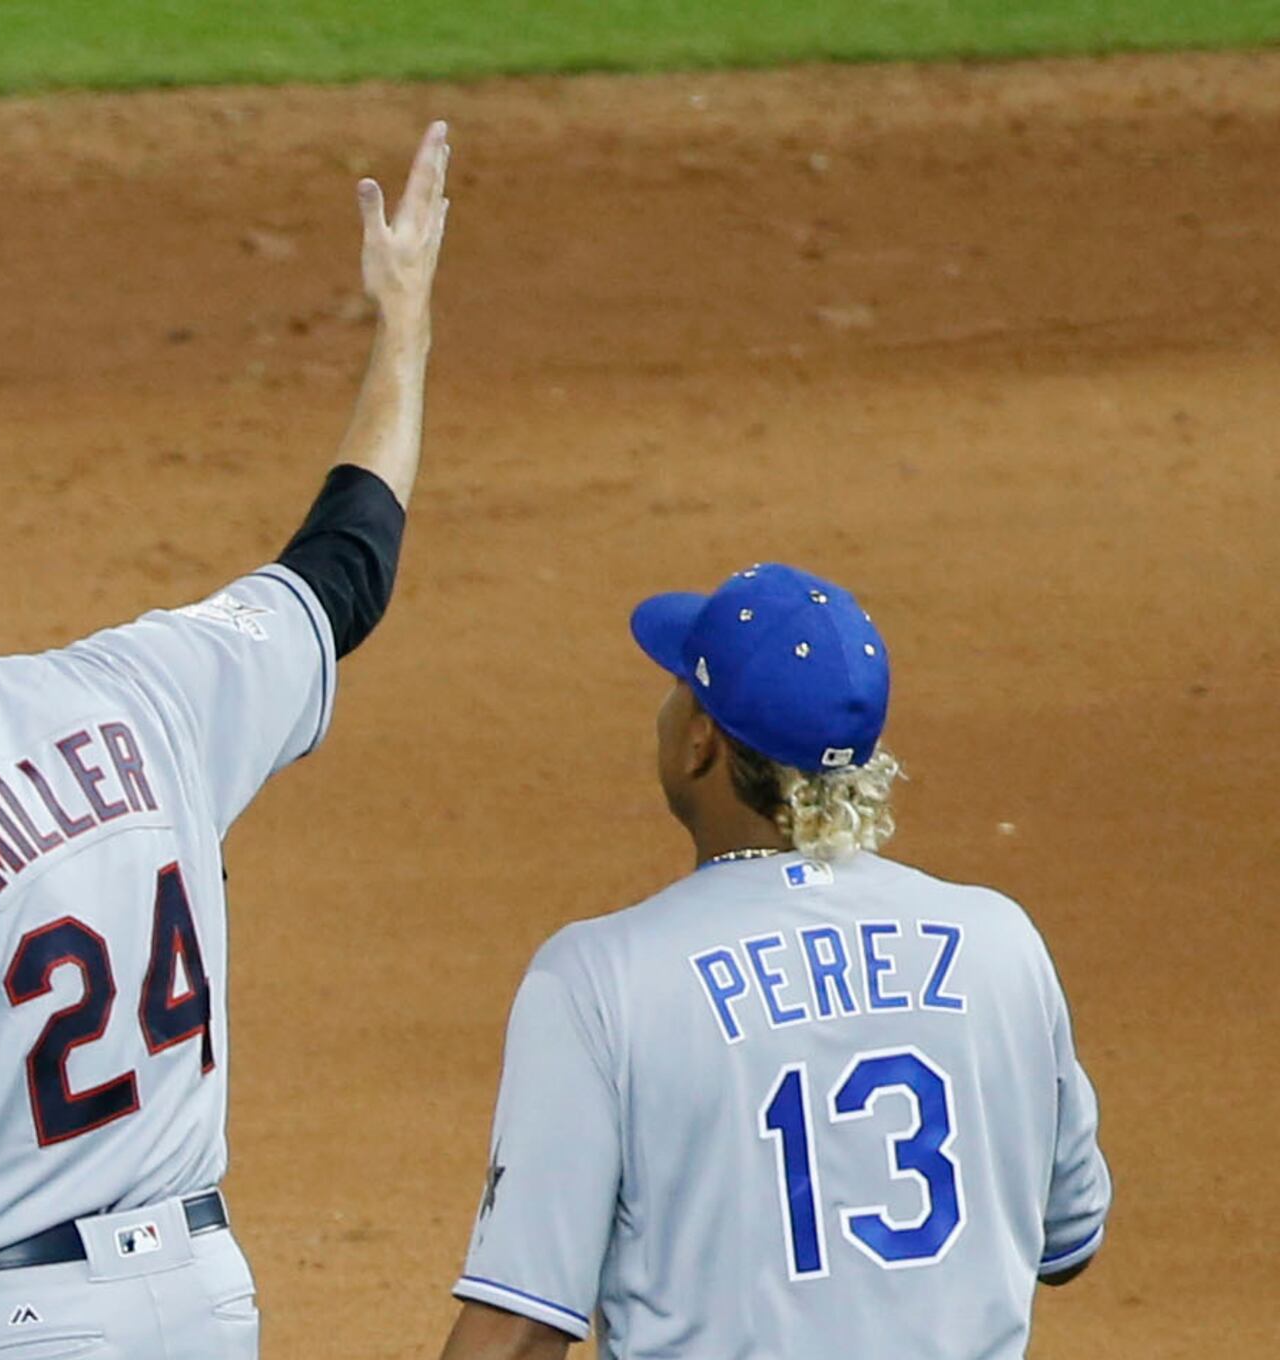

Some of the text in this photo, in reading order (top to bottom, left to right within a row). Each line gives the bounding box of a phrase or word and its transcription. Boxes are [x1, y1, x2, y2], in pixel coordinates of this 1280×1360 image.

[3, 860, 216, 1149] 24
[688, 918, 967, 1045] PEREZ
[757, 1044, 968, 1283] 13
